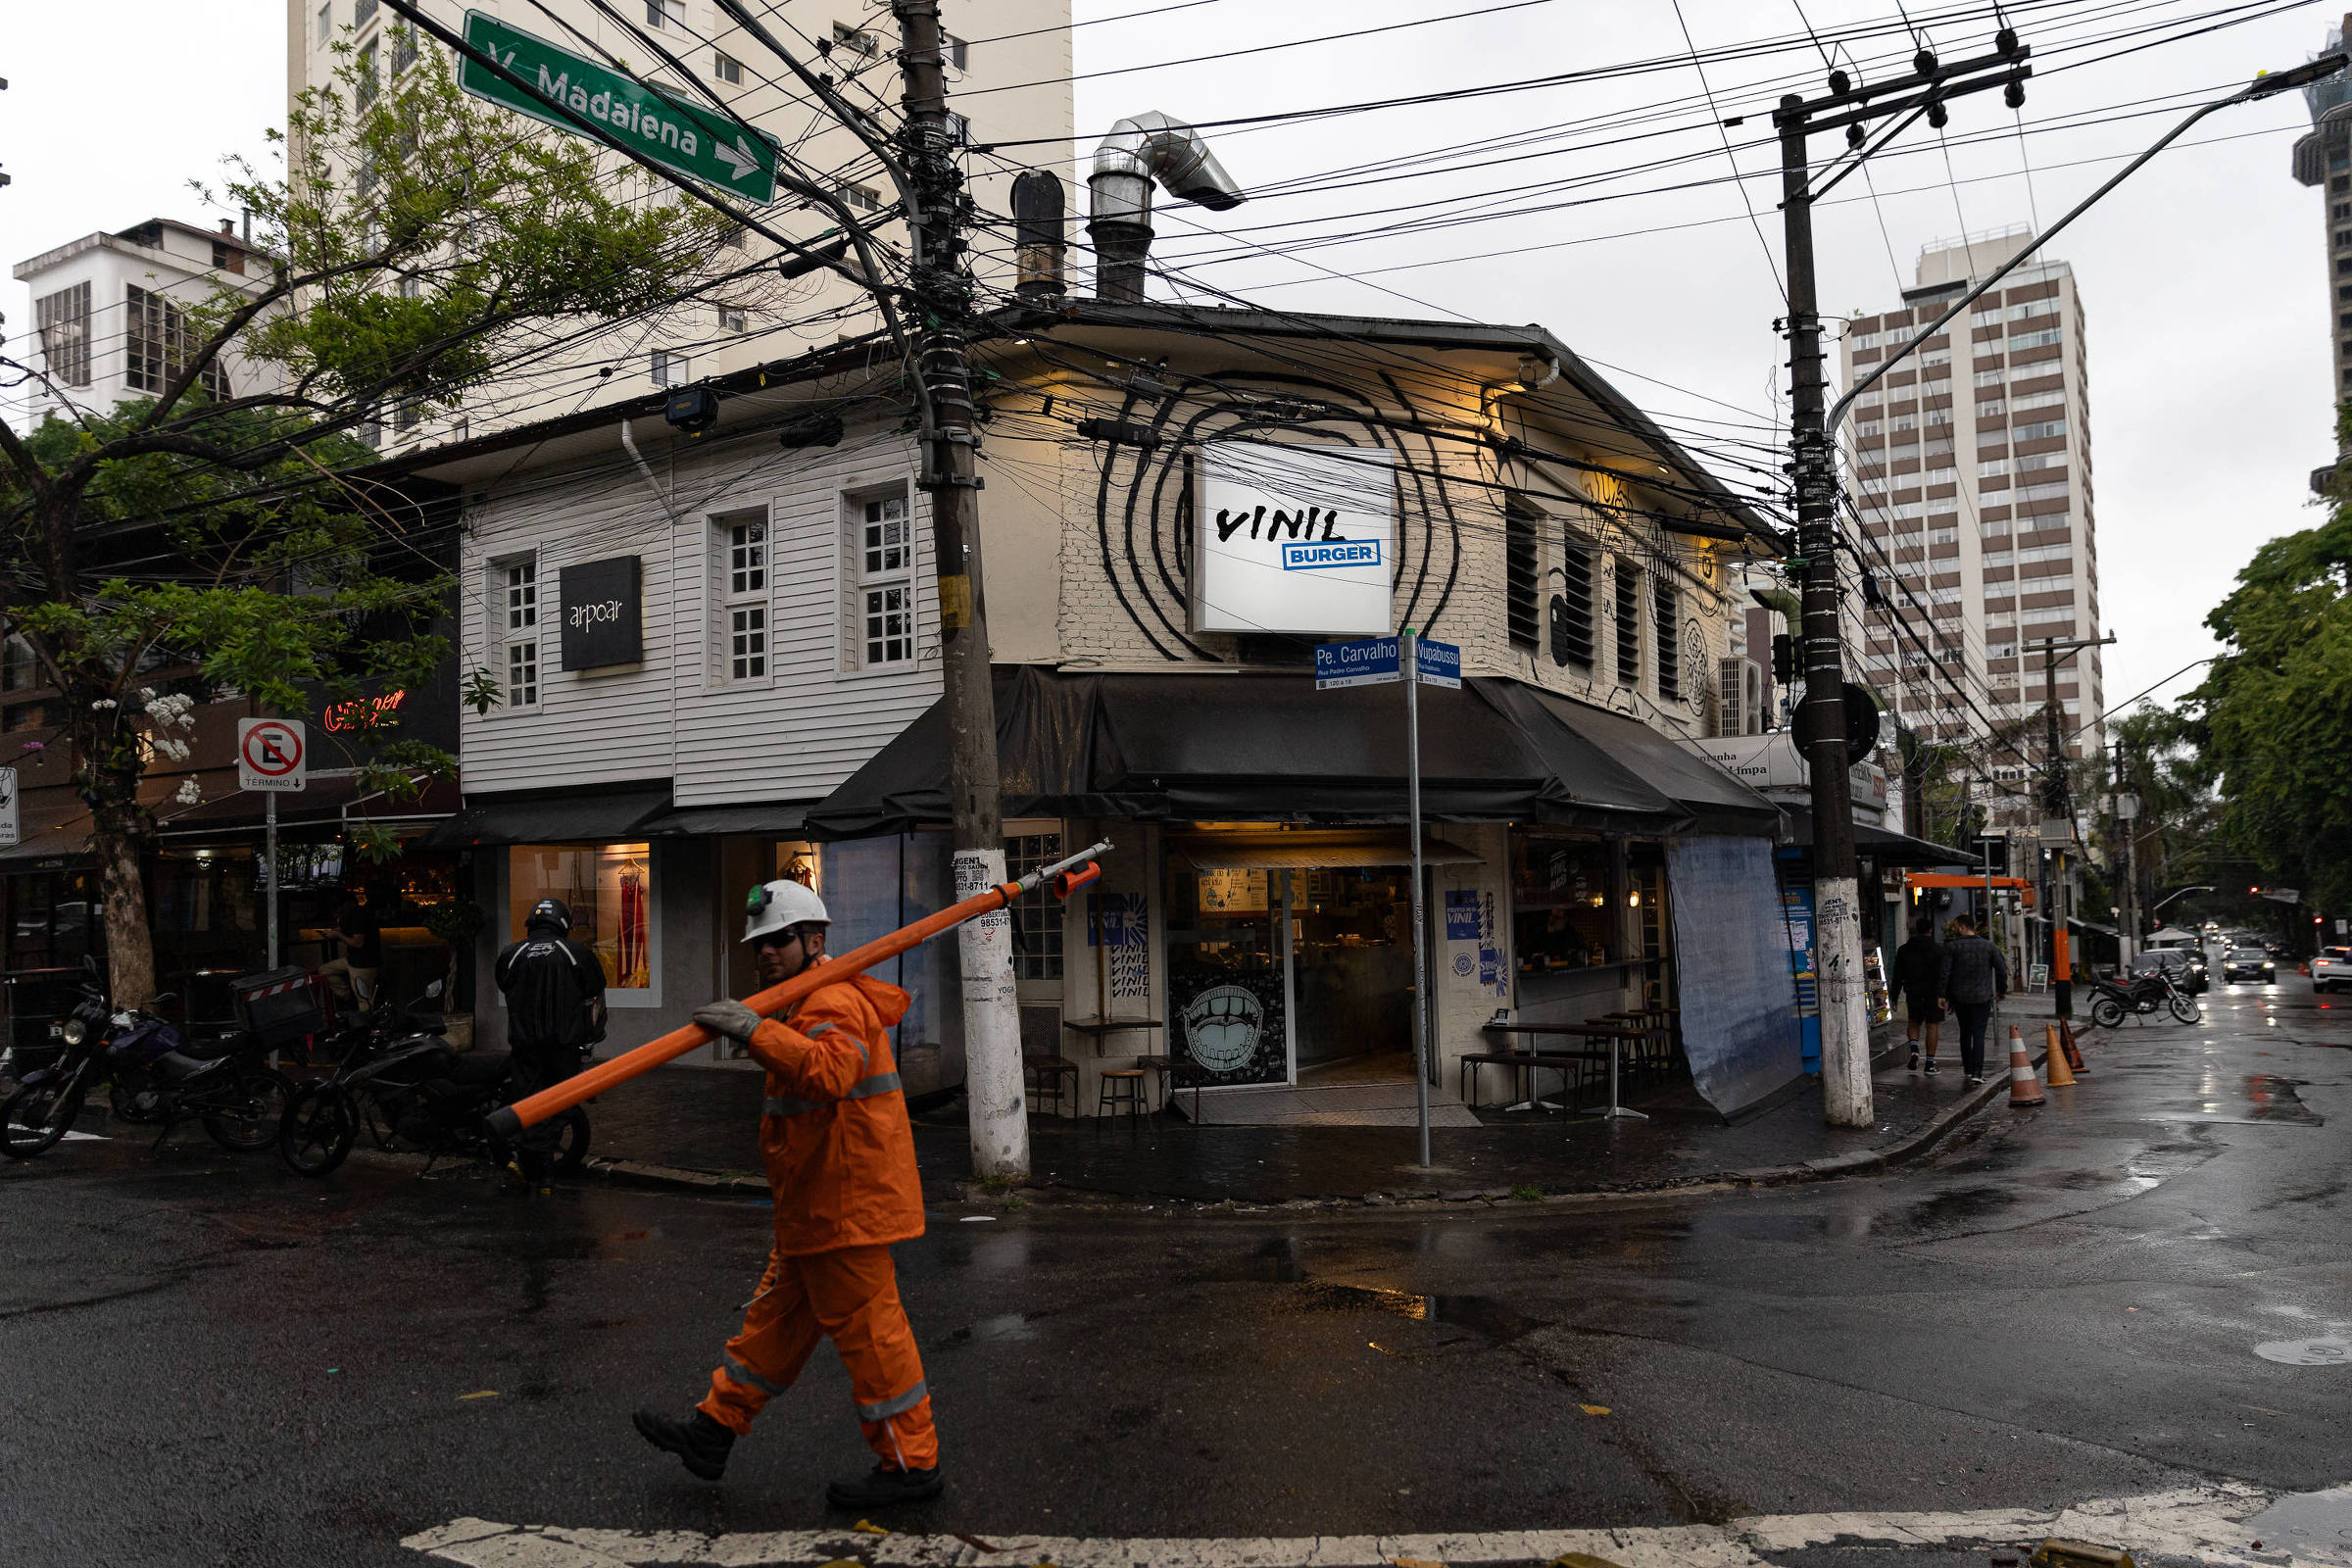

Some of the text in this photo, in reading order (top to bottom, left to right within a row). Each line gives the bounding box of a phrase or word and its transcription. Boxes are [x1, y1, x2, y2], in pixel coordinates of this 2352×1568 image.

[538, 63, 697, 157] Madalena
[1216, 506, 1346, 542] VINIL
[1290, 546, 1372, 564] BURGER
[569, 599, 623, 632] arpoar
[1317, 643, 1396, 665] Pe. Carvalho
